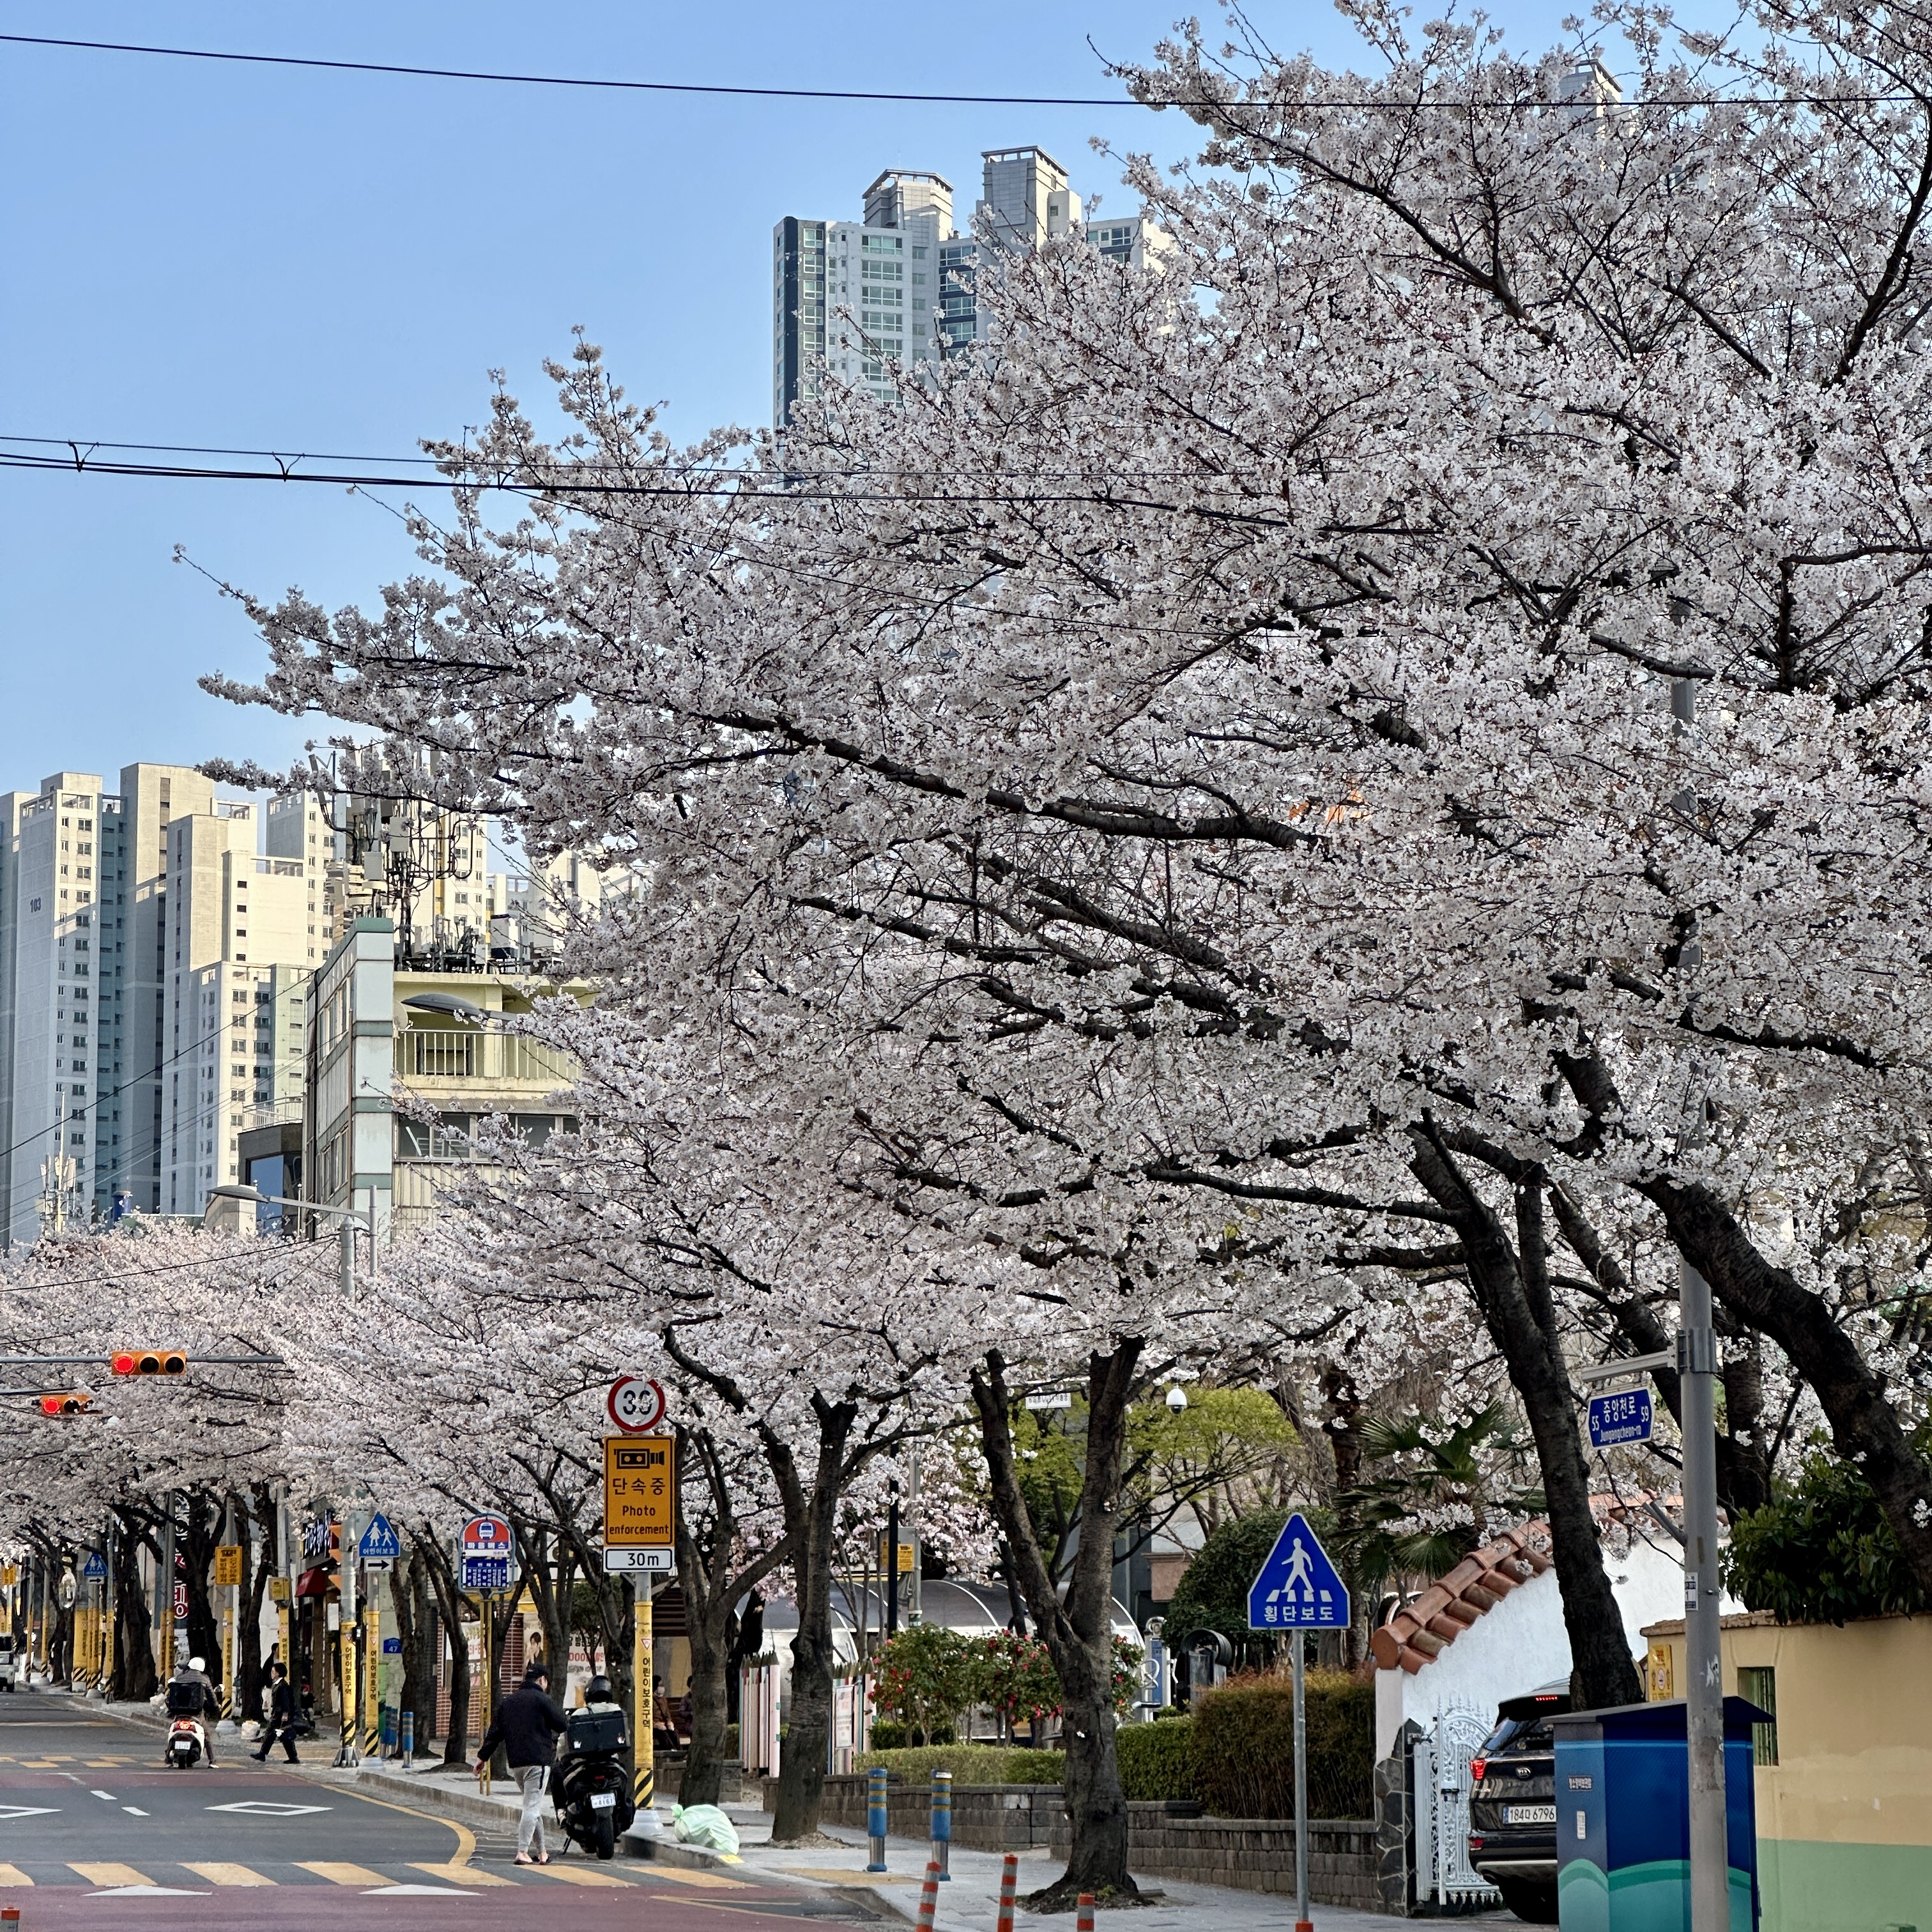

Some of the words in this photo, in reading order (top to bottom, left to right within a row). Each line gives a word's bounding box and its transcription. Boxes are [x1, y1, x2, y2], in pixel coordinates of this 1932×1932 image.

[30, 897, 42, 913] 103
[622, 1390, 652, 1415] 30
[1602, 1396, 1636, 1423] 중앙천로
[1640, 1406, 1650, 1423] 59
[1591, 1415, 1600, 1432] 55
[613, 1477, 665, 1496] 단속중
[622, 1505, 656, 1516] Photo
[609, 1524, 669, 1535] enforcement
[627, 1552, 659, 1567] 30m
[1264, 1606, 1334, 1623] 횡단보도
[642, 1657, 650, 1729] 어린이보호구역
[1533, 1807, 1554, 1820] 6796
